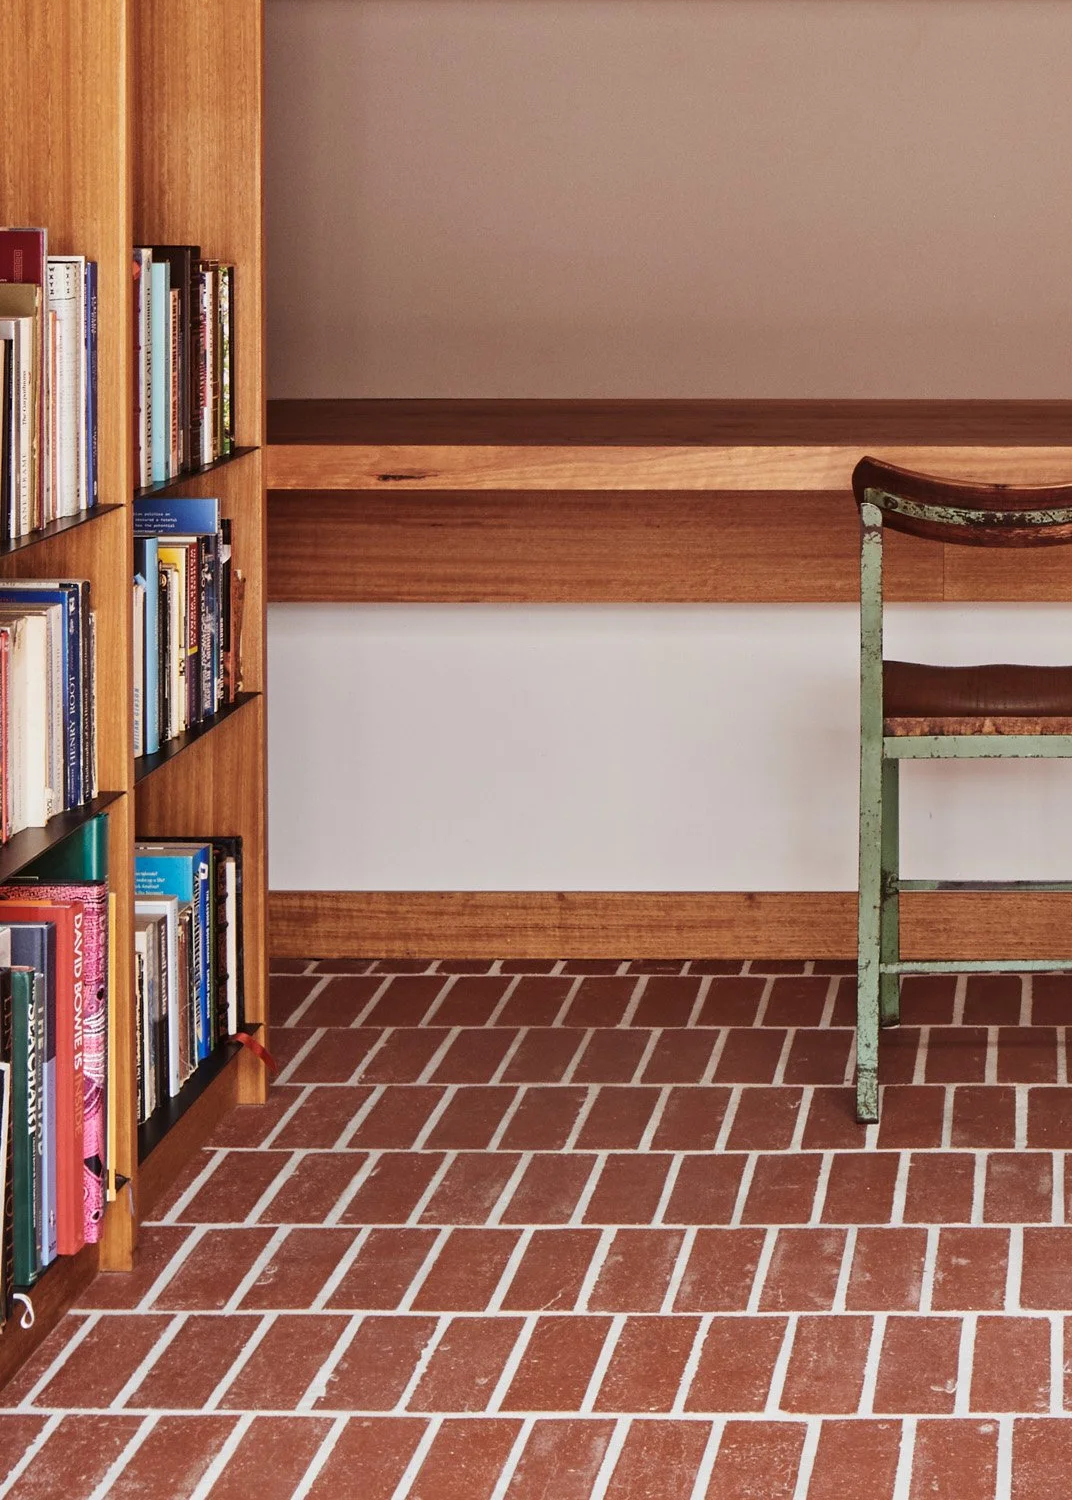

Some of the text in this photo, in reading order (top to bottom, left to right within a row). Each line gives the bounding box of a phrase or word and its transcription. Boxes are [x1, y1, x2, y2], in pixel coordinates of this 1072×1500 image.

[146, 380, 152, 399] OF
[74, 912, 83, 1135] DAVID BOWIE IS INSIDE
